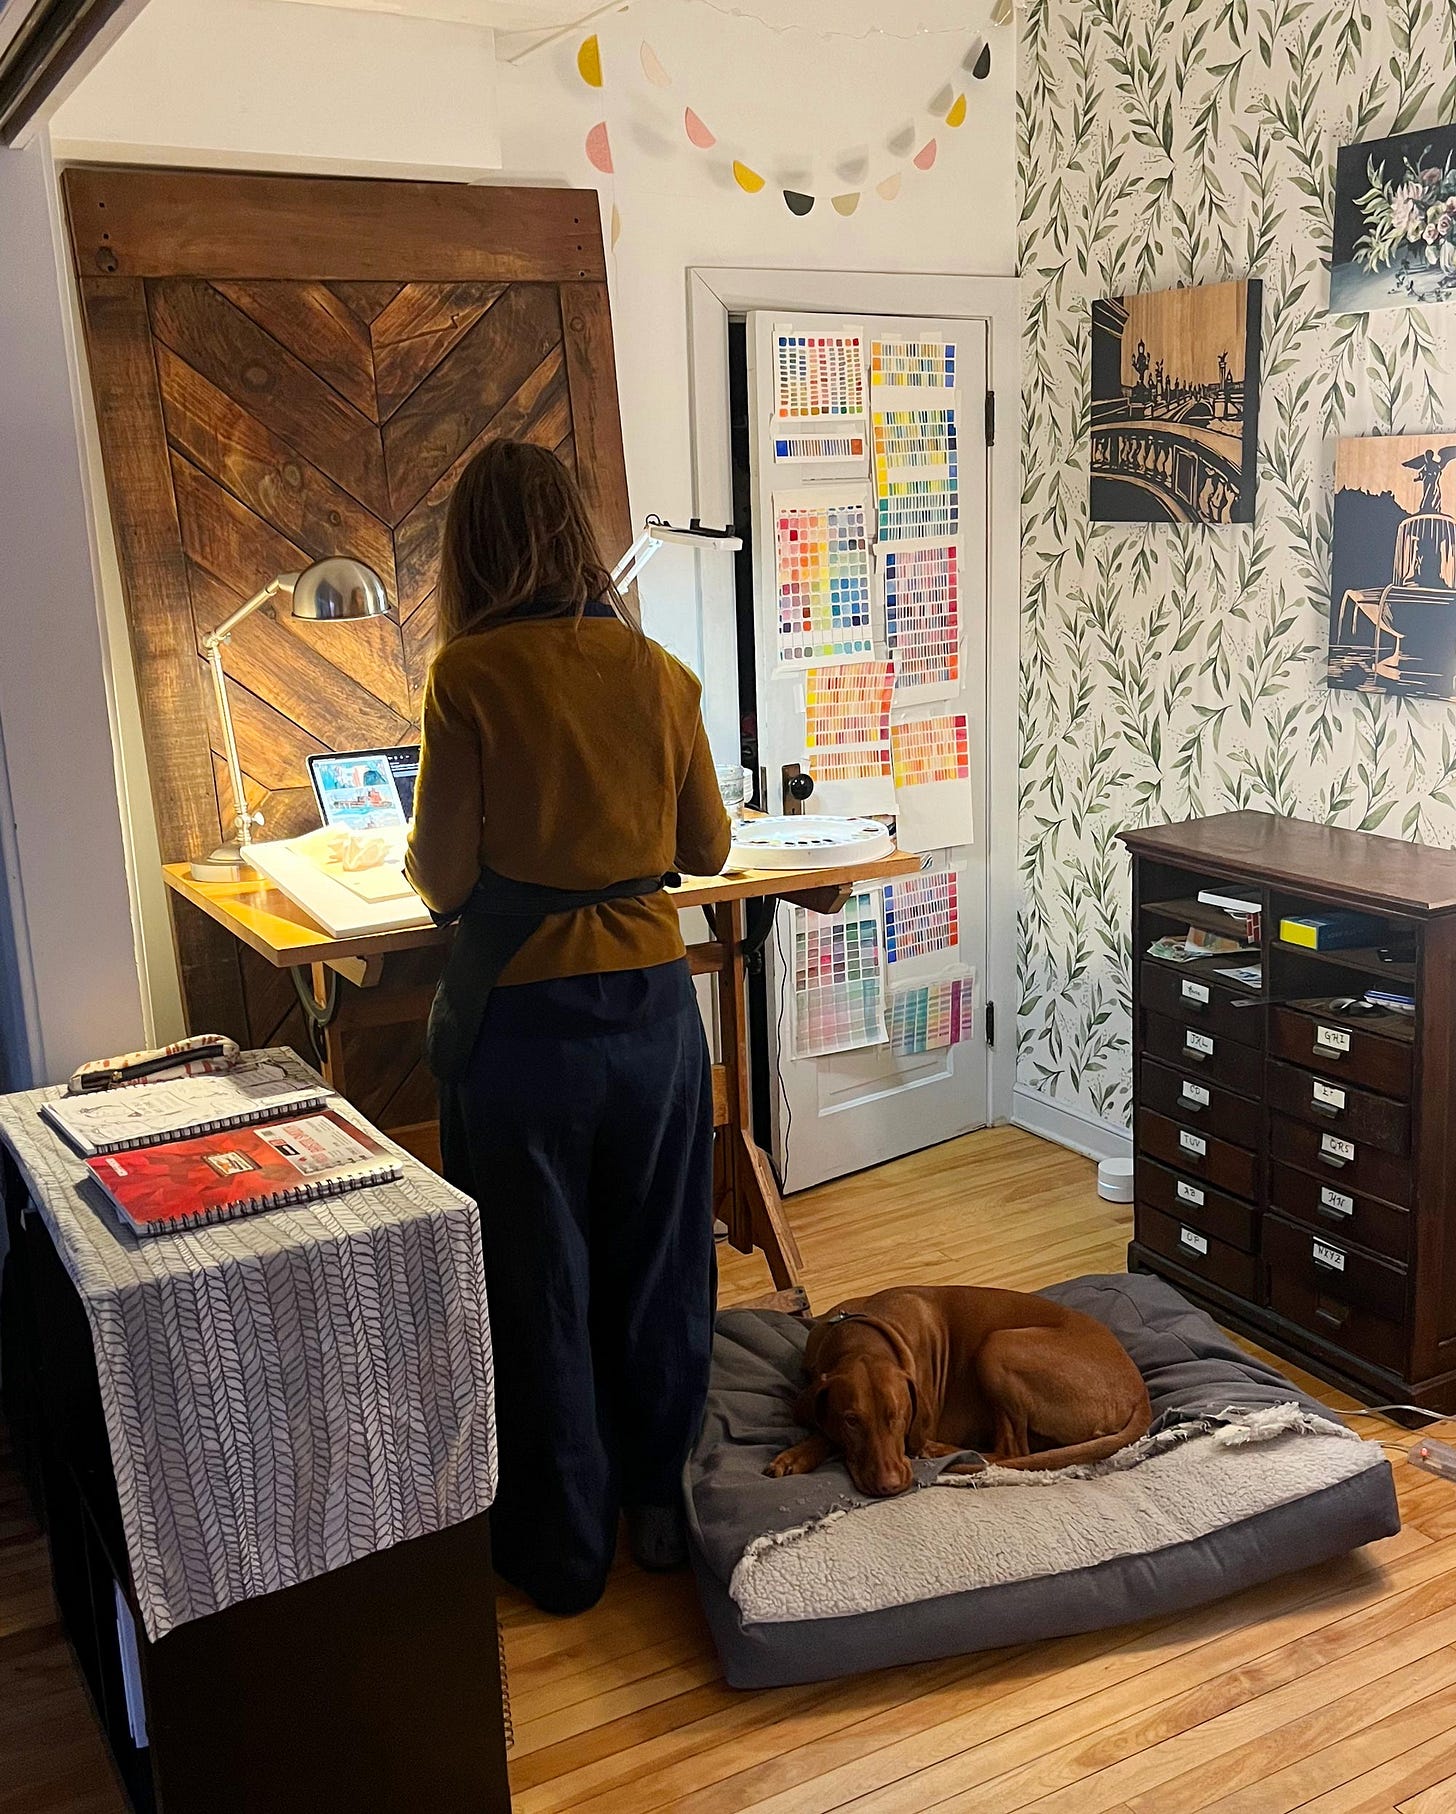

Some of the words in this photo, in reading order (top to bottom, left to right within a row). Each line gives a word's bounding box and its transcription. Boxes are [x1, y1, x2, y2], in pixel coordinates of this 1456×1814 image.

[1324, 1031, 1345, 1044] GHI
[1183, 1134, 1201, 1147] TUV
[1329, 1138, 1349, 1153] QRS
